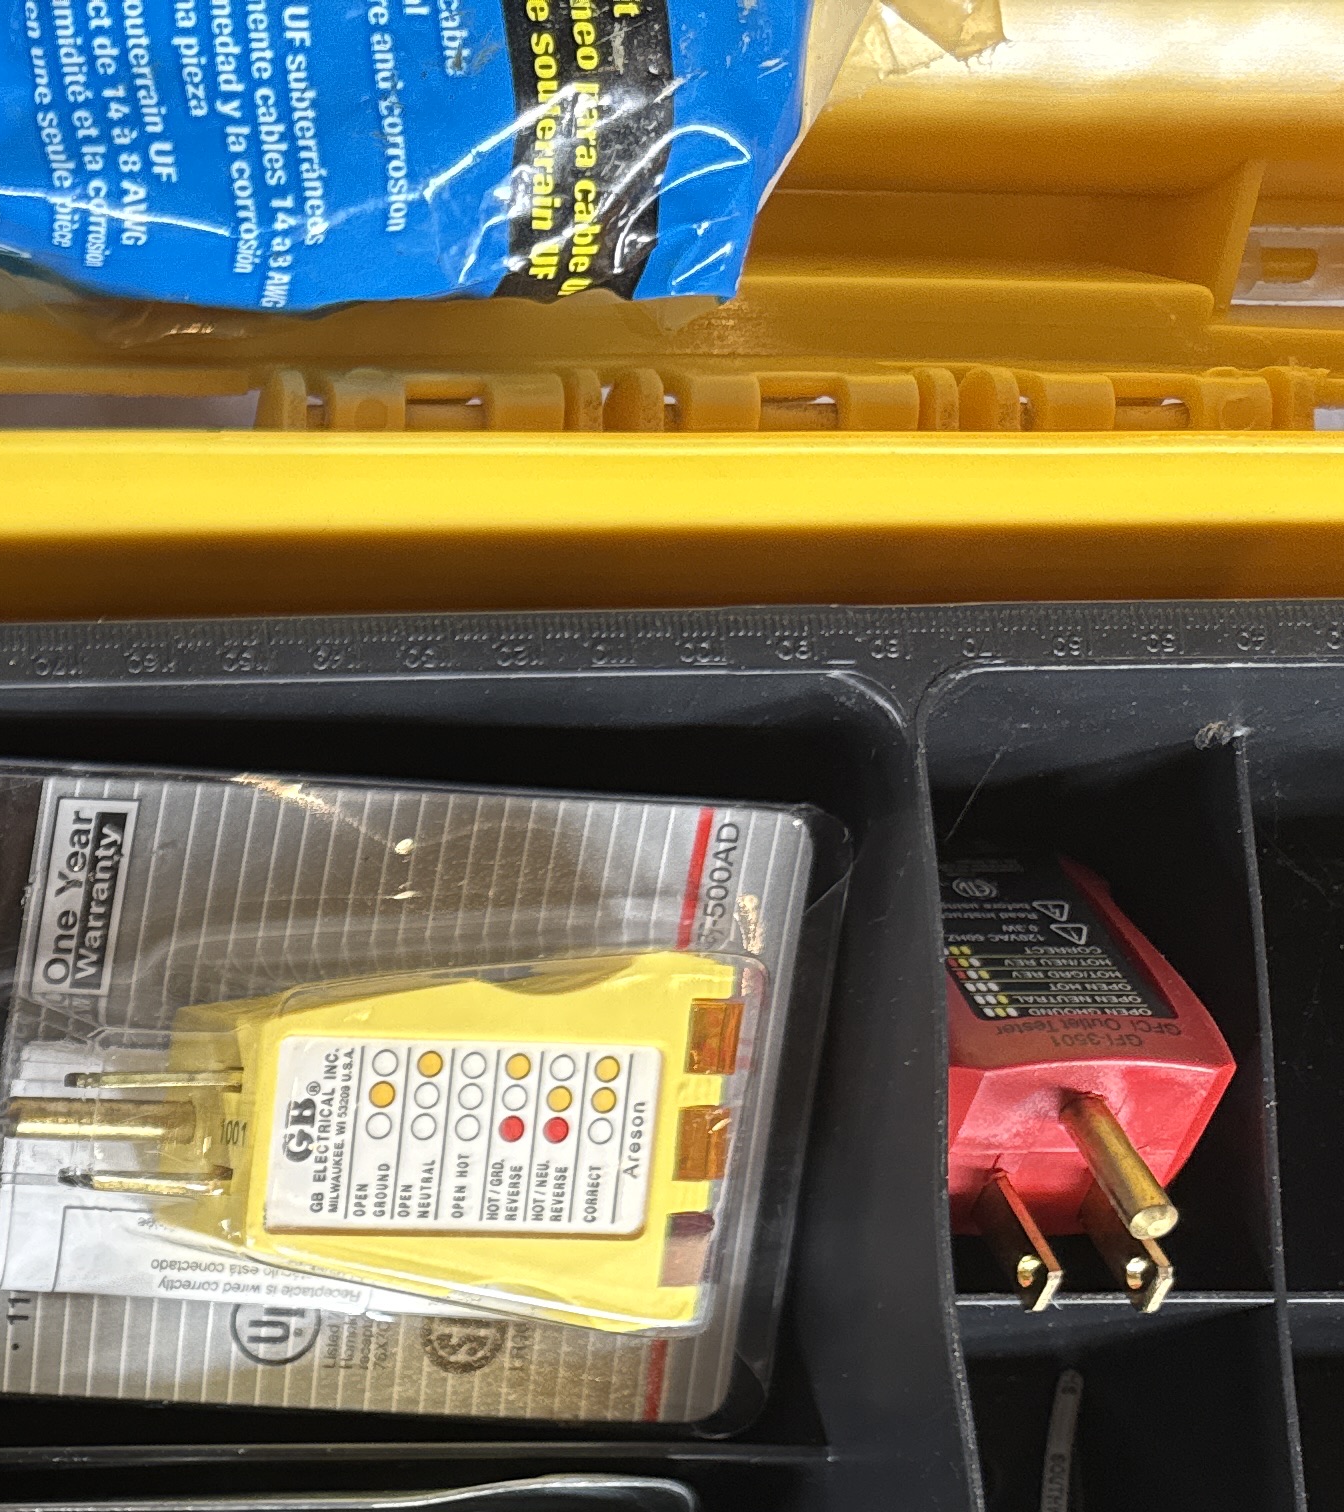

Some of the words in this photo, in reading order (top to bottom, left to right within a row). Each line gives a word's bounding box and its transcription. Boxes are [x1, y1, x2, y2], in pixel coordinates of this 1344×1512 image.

[282, 6, 310, 47] UF
[91, 36, 119, 75] de
[29, 46, 52, 105] une
[171, 36, 207, 117] pieza
[101, 84, 128, 120] 14
[215, 99, 242, 118] y
[73, 109, 98, 139] et
[112, 126, 137, 145] à
[225, 125, 250, 152] la
[254, 87, 287, 185] cables
[37, 111, 77, 188] seule
[82, 145, 106, 171] la
[118, 153, 141, 173] 8
[148, 141, 177, 182] UF
[288, 54, 328, 245] subterráneos
[378, 97, 409, 232] corrosion
[231, 160, 262, 273] corrosión
[271, 196, 295, 231] 14
[568, 179, 600, 272] cable
[527, 242, 557, 280] UF
[260, 271, 291, 308] AWG
[54, 810, 93, 900] Year
[74, 822, 124, 981] Warranty
[43, 909, 78, 987] One
[1003, 958, 1037, 966] REV
[1023, 945, 1102, 954] CORRECT
[1038, 958, 1111, 966] HOT/NEU
[1010, 970, 1044, 978] REV
[1046, 969, 1122, 978] HOT/GRD
[1048, 982, 1081, 990] HOT
[1083, 981, 1131, 990] OPEN
[1011, 994, 1091, 1003] NEUTRAL
[1027, 1006, 1101, 1016] GROUND
[1093, 994, 1142, 1003] OPEN
[1103, 1006, 1152, 1016] OPEN
[995, 1021, 1054, 1035] Tester
[1049, 1032, 1143, 1047] GFI-3501
[1059, 1016, 1121, 1031] Outlet
[323, 1047, 340, 1080] INC.
[340, 1046, 355, 1082] U.S.A.
[219, 1119, 248, 1147] 1001
[312, 1085, 336, 1182] ELECTRICAL
[334, 1119, 347, 1136] WI
[622, 1099, 646, 1178] Areson
[455, 1152, 470, 1178] HOT
[309, 1191, 325, 1213] GB
[352, 1182, 369, 1217] OPEN
[372, 1162, 391, 1217] GROUND
[397, 1183, 413, 1218] OPEN
[416, 1158, 436, 1219] NEUTRAL
[450, 1184, 467, 1219] OPEN
[504, 1164, 523, 1221] REVERSE
[549, 1165, 569, 1222] REVERSE
[582, 1164, 602, 1223] CORRECT
[149, 1257, 225, 1277] conectado
[228, 1262, 260, 1278] está
[157, 1273, 219, 1295] correctly
[222, 1280, 261, 1297] wired
[280, 1282, 362, 1303] Receptacle
